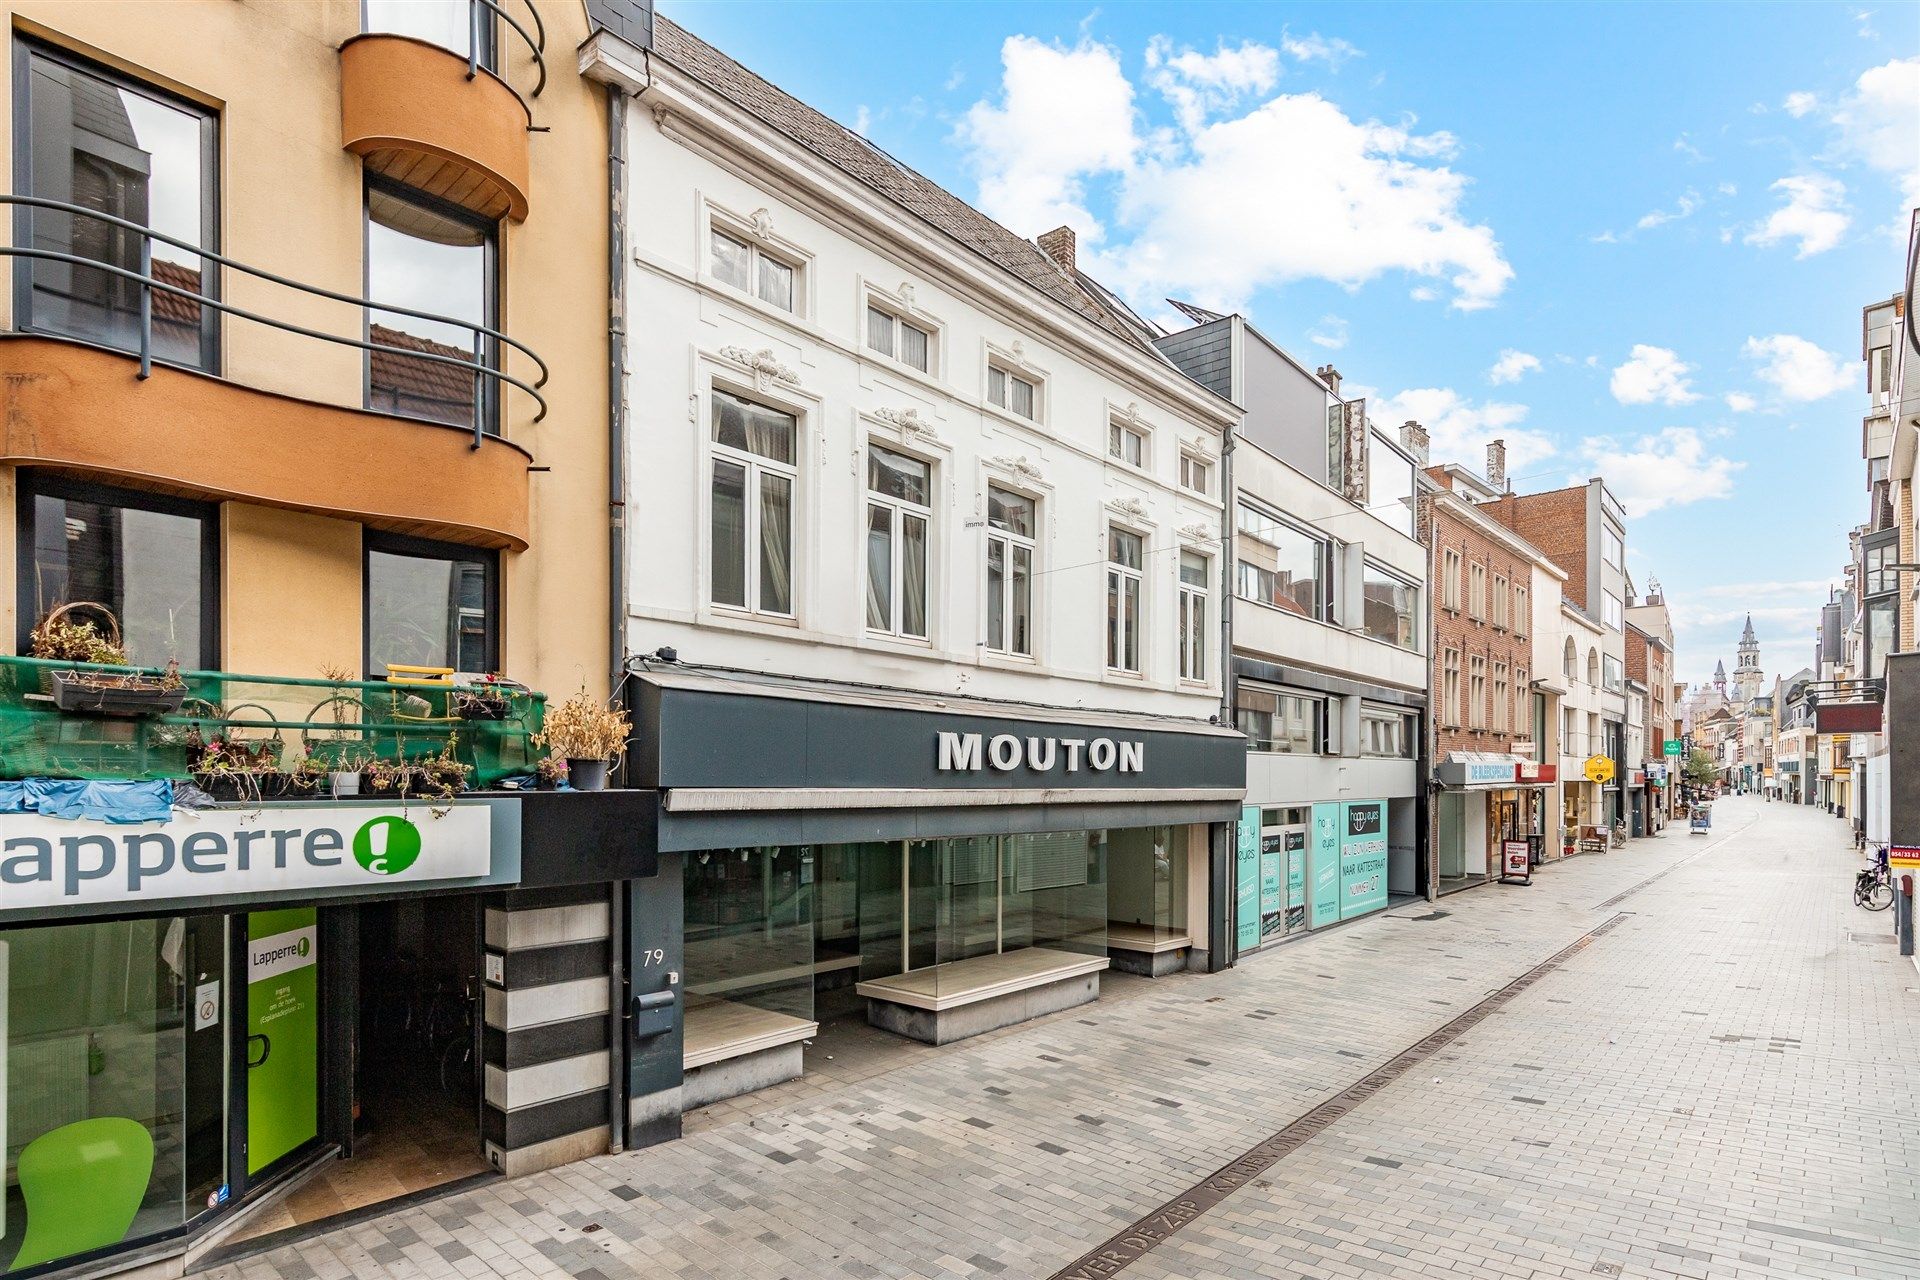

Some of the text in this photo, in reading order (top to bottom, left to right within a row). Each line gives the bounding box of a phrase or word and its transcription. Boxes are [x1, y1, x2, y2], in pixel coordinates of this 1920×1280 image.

[937, 730, 1144, 772] MOUTON
[0, 828, 343, 896] apperre
[1342, 858, 1386, 876] NAAR KATTESTRAAT
[1371, 875, 1380, 892] 27
[253, 944, 297, 966] Lapperre
[643, 948, 664, 967] 79
[285, 997, 296, 1006] hoek
[1341, 1072, 1391, 1102] KATJEN
[1204, 1148, 1279, 1194] KATJEN
[1119, 1226, 1166, 1251] DE
